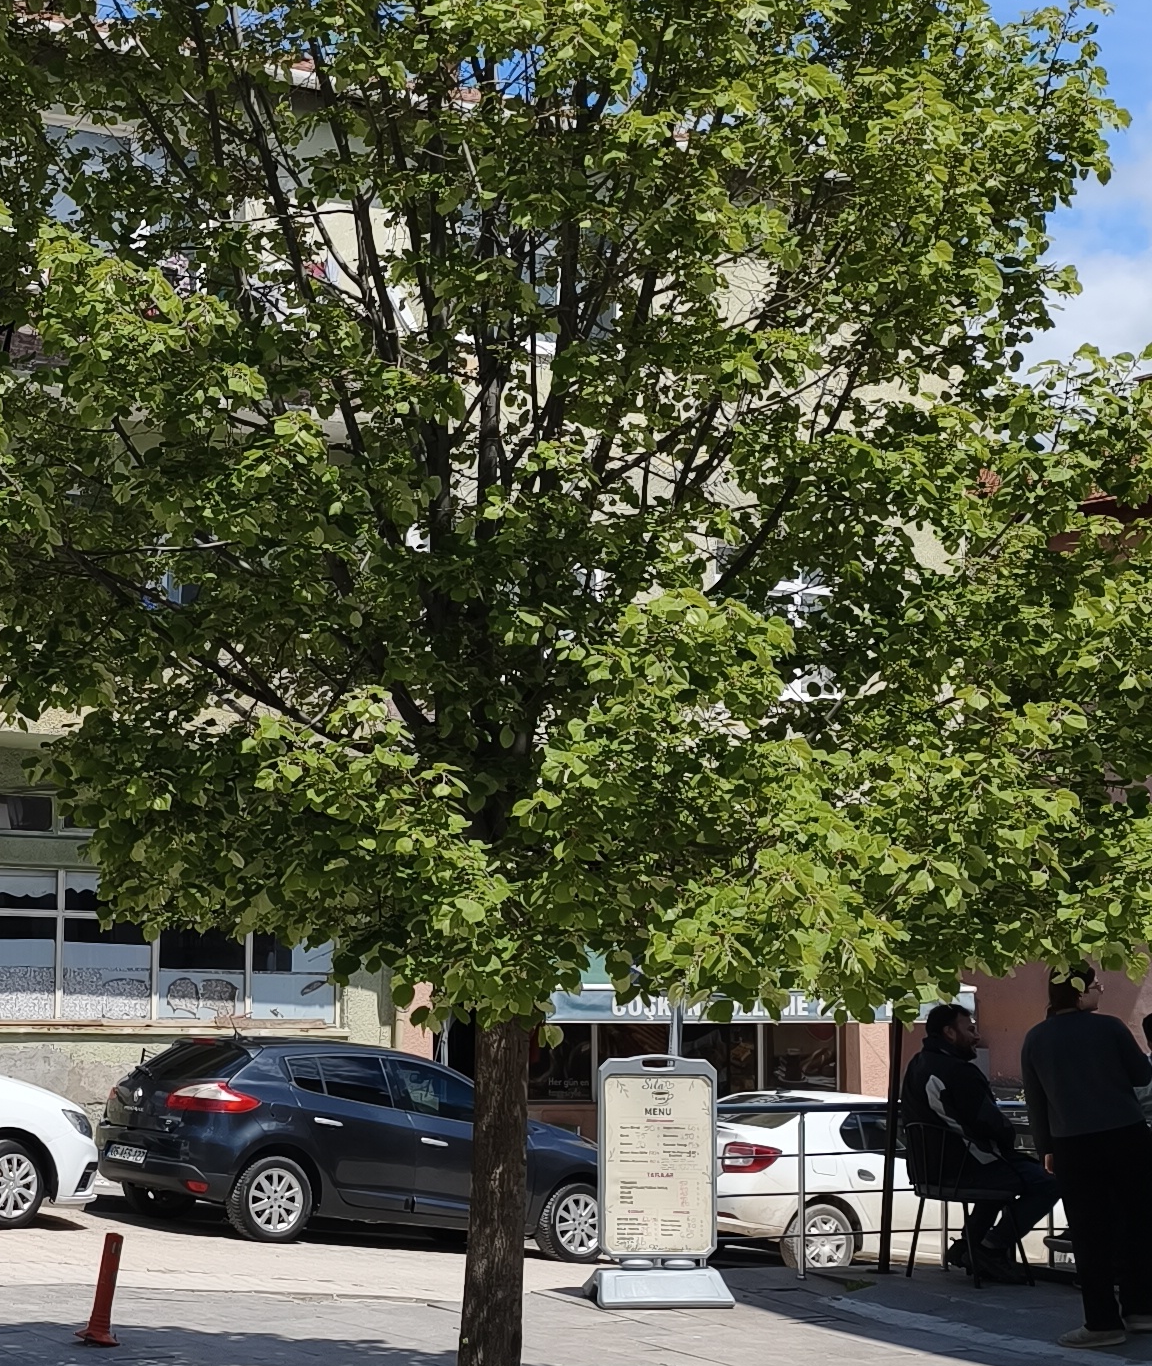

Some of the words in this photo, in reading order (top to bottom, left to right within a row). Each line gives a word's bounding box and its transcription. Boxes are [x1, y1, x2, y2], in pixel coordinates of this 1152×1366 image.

[611, 993, 704, 1021] COŞKN
[548, 1077, 563, 1086] Her
[644, 1107, 672, 1116] MENU
